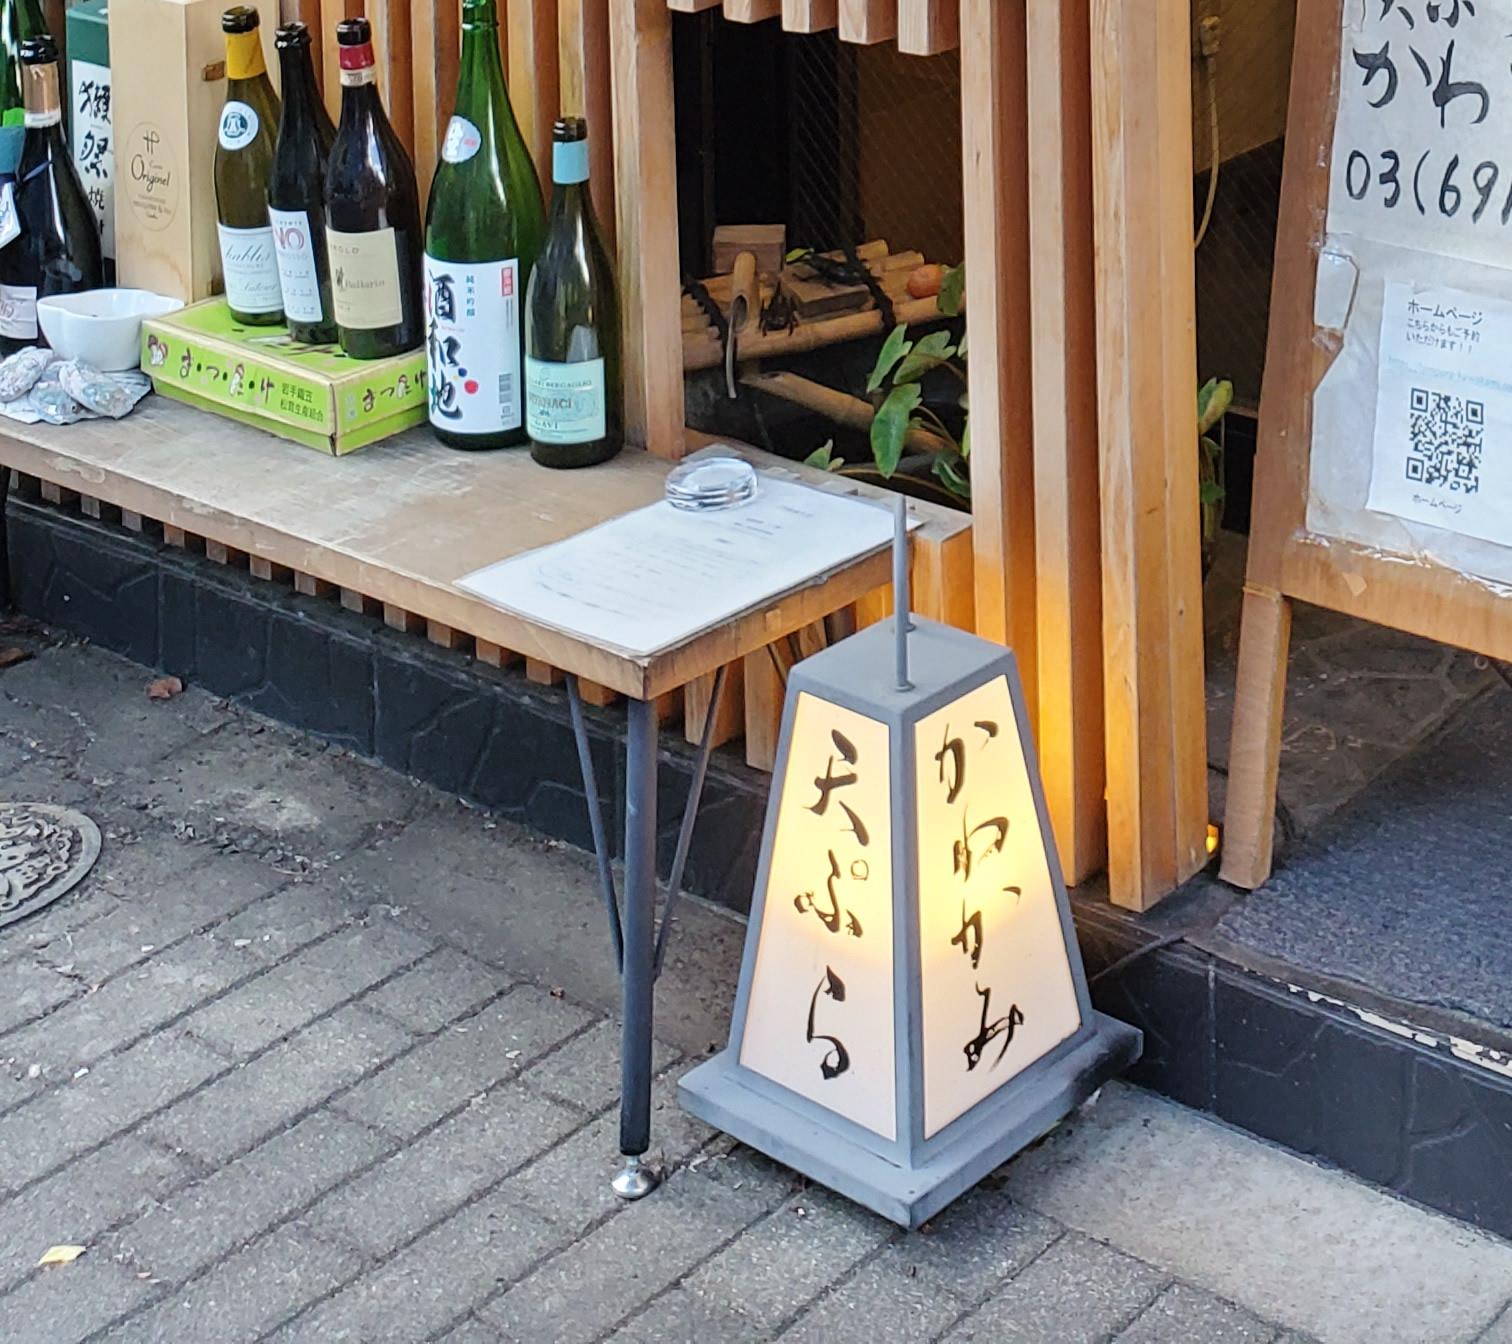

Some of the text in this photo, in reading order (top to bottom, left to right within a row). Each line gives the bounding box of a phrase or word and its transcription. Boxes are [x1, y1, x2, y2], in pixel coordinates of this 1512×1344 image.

[1407, 298, 1484, 326] ホームページ
[1406, 317, 1481, 344] こちらからもご予約
[1411, 493, 1463, 514] ホームページ
[793, 728, 870, 1082] 天ぷら
[934, 720, 1025, 1074] かわかみ
